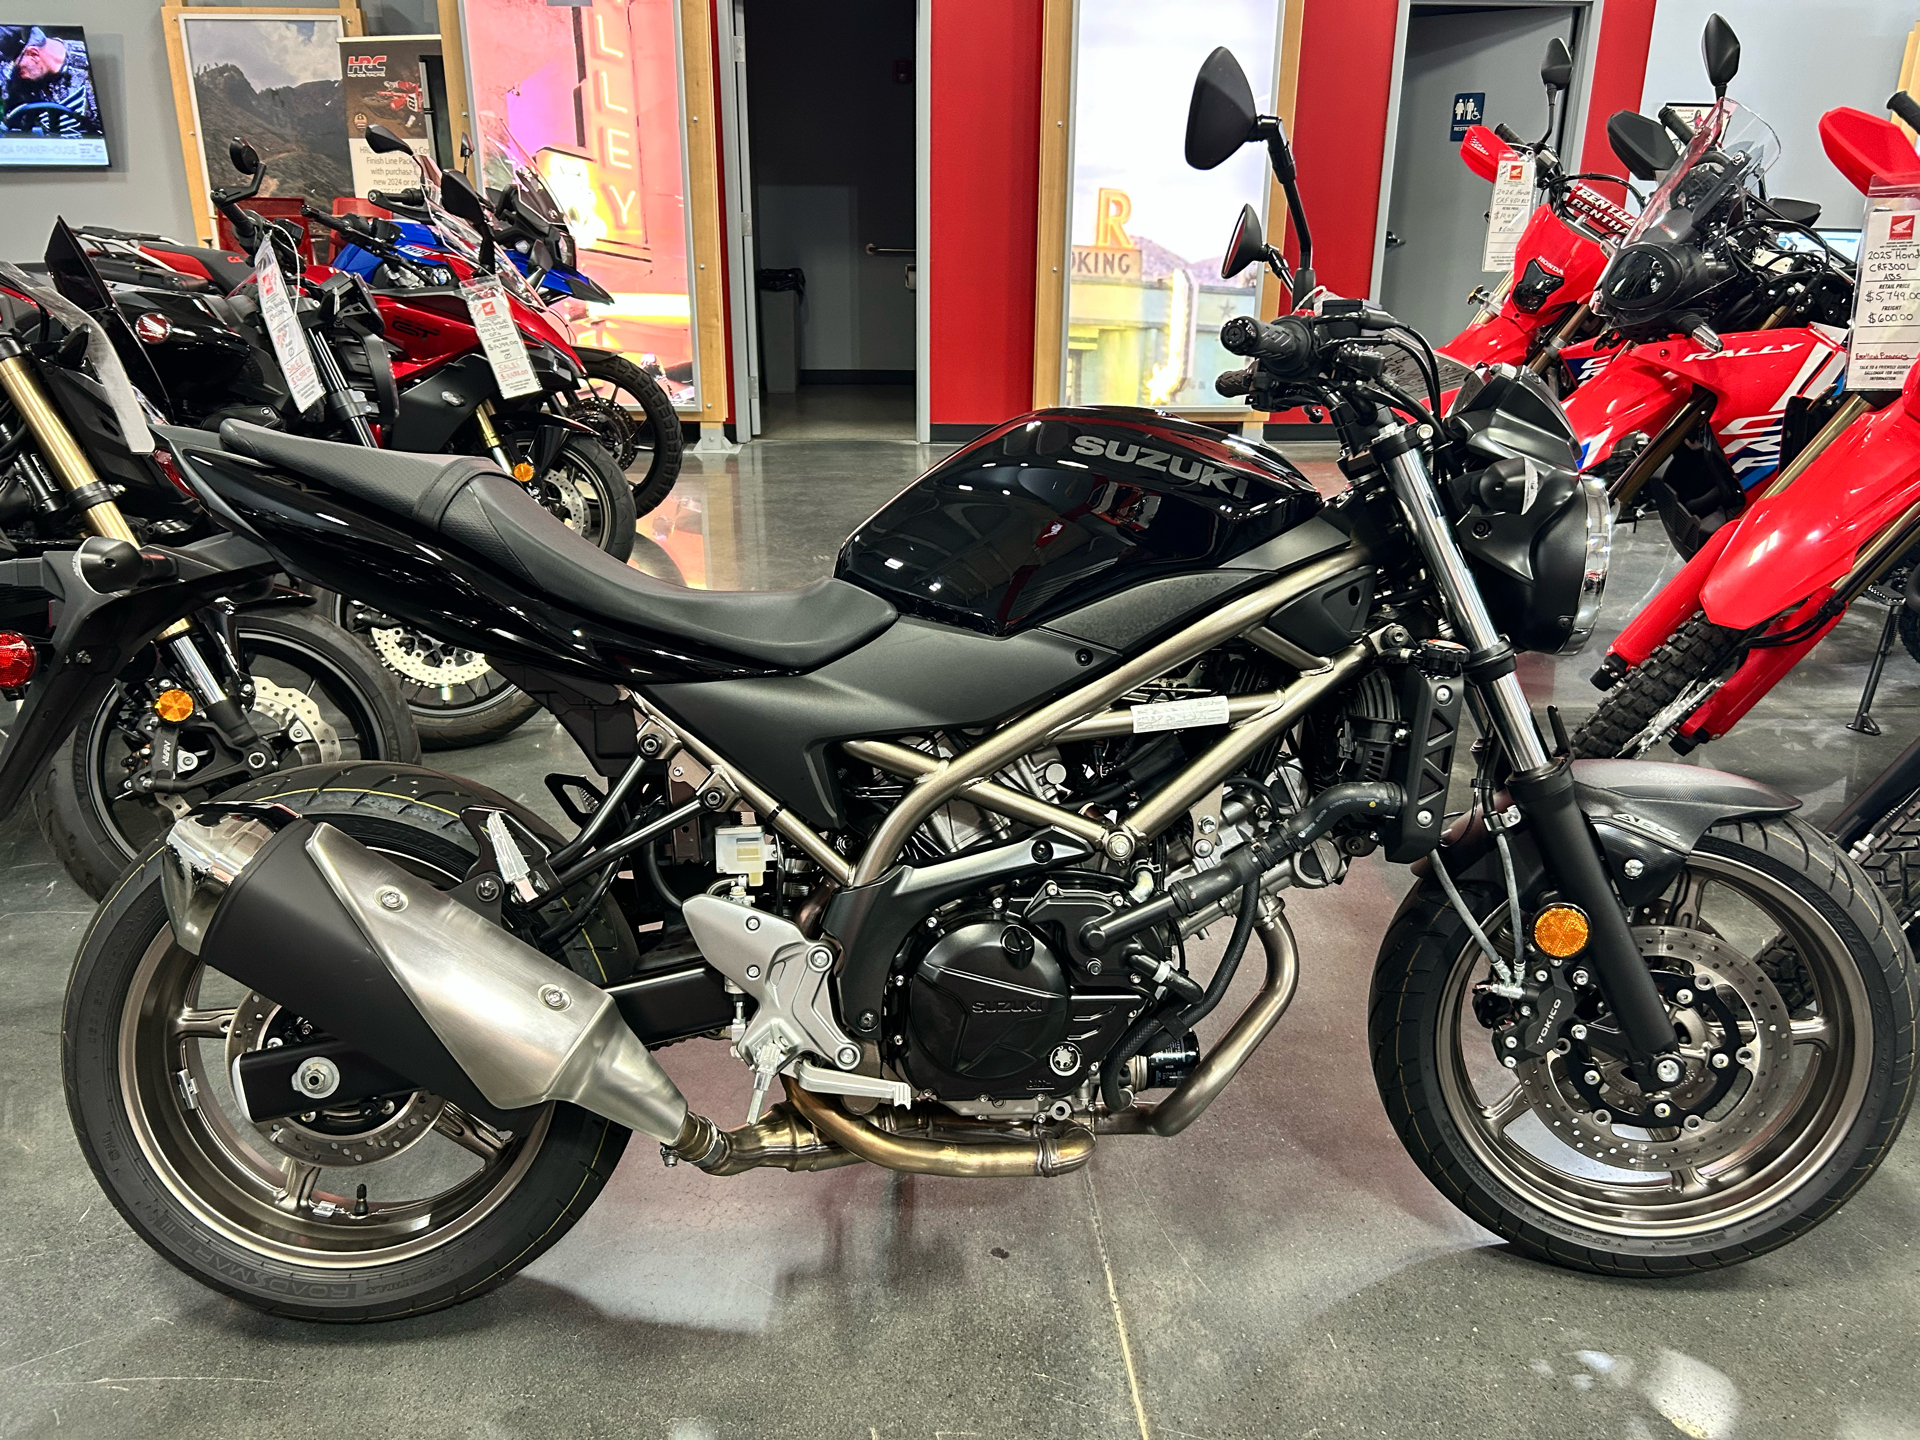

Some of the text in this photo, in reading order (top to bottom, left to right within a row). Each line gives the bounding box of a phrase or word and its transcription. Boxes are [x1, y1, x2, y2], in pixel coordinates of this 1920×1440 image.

[347, 55, 387, 74] HRC
[366, 156, 384, 165] Finish
[385, 156, 398, 165] Line
[387, 178, 402, 186] 2024
[1096, 187, 1132, 248] R
[1570, 198, 1631, 236] RENTHA
[1575, 188, 1637, 228] RENTHA
[1867, 248, 1920, 260] 2025 Hond
[1537, 255, 1565, 276] HONDA
[1869, 262, 1917, 273] CRF300L
[1883, 273, 1903, 281] ABS
[1682, 343, 1805, 363] RALLY
[1072, 435, 1249, 500] SUZUKI
[1613, 813, 1681, 841] ABS
[972, 1001, 1043, 1014] SUZUKI
[1536, 998, 1562, 1045] TOKICO
[1450, 1139, 1521, 1210] ROADSMART
[177, 1234, 350, 1299] ROADSMART
